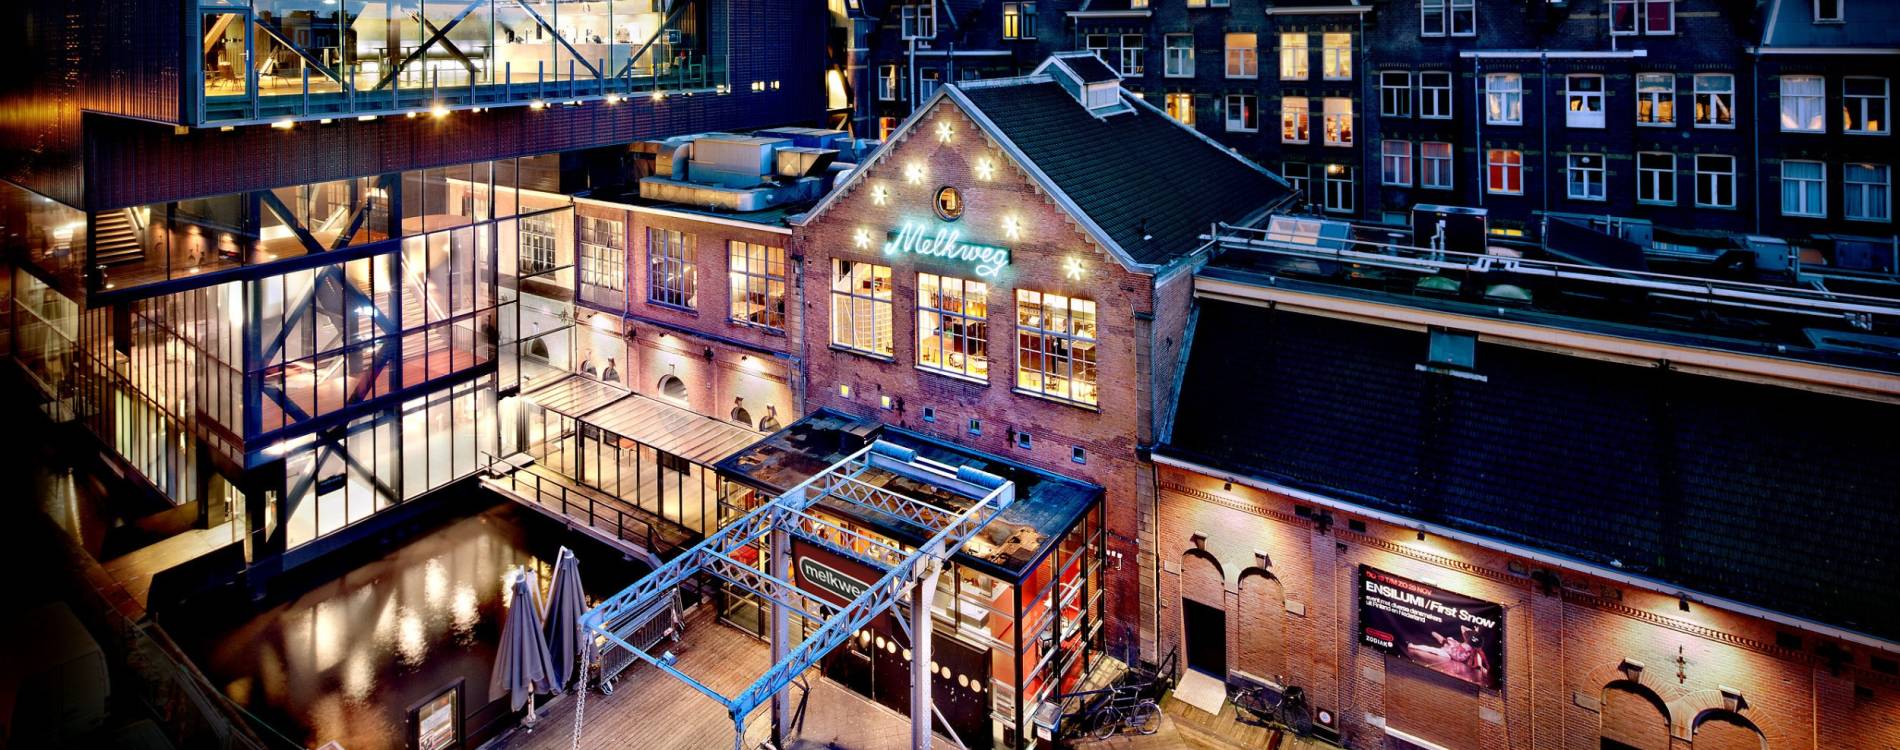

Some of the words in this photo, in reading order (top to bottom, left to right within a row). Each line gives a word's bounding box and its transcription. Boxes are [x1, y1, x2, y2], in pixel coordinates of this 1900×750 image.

[884, 222, 1010, 277] Melkweg
[805, 564, 865, 597] melkwe
[1417, 586, 1432, 595] NOV
[1365, 580, 1425, 608] ENSILUMI
[1430, 601, 1458, 618] First
[1458, 609, 1496, 629] Snow
[1365, 635, 1388, 647] ZODIAK
